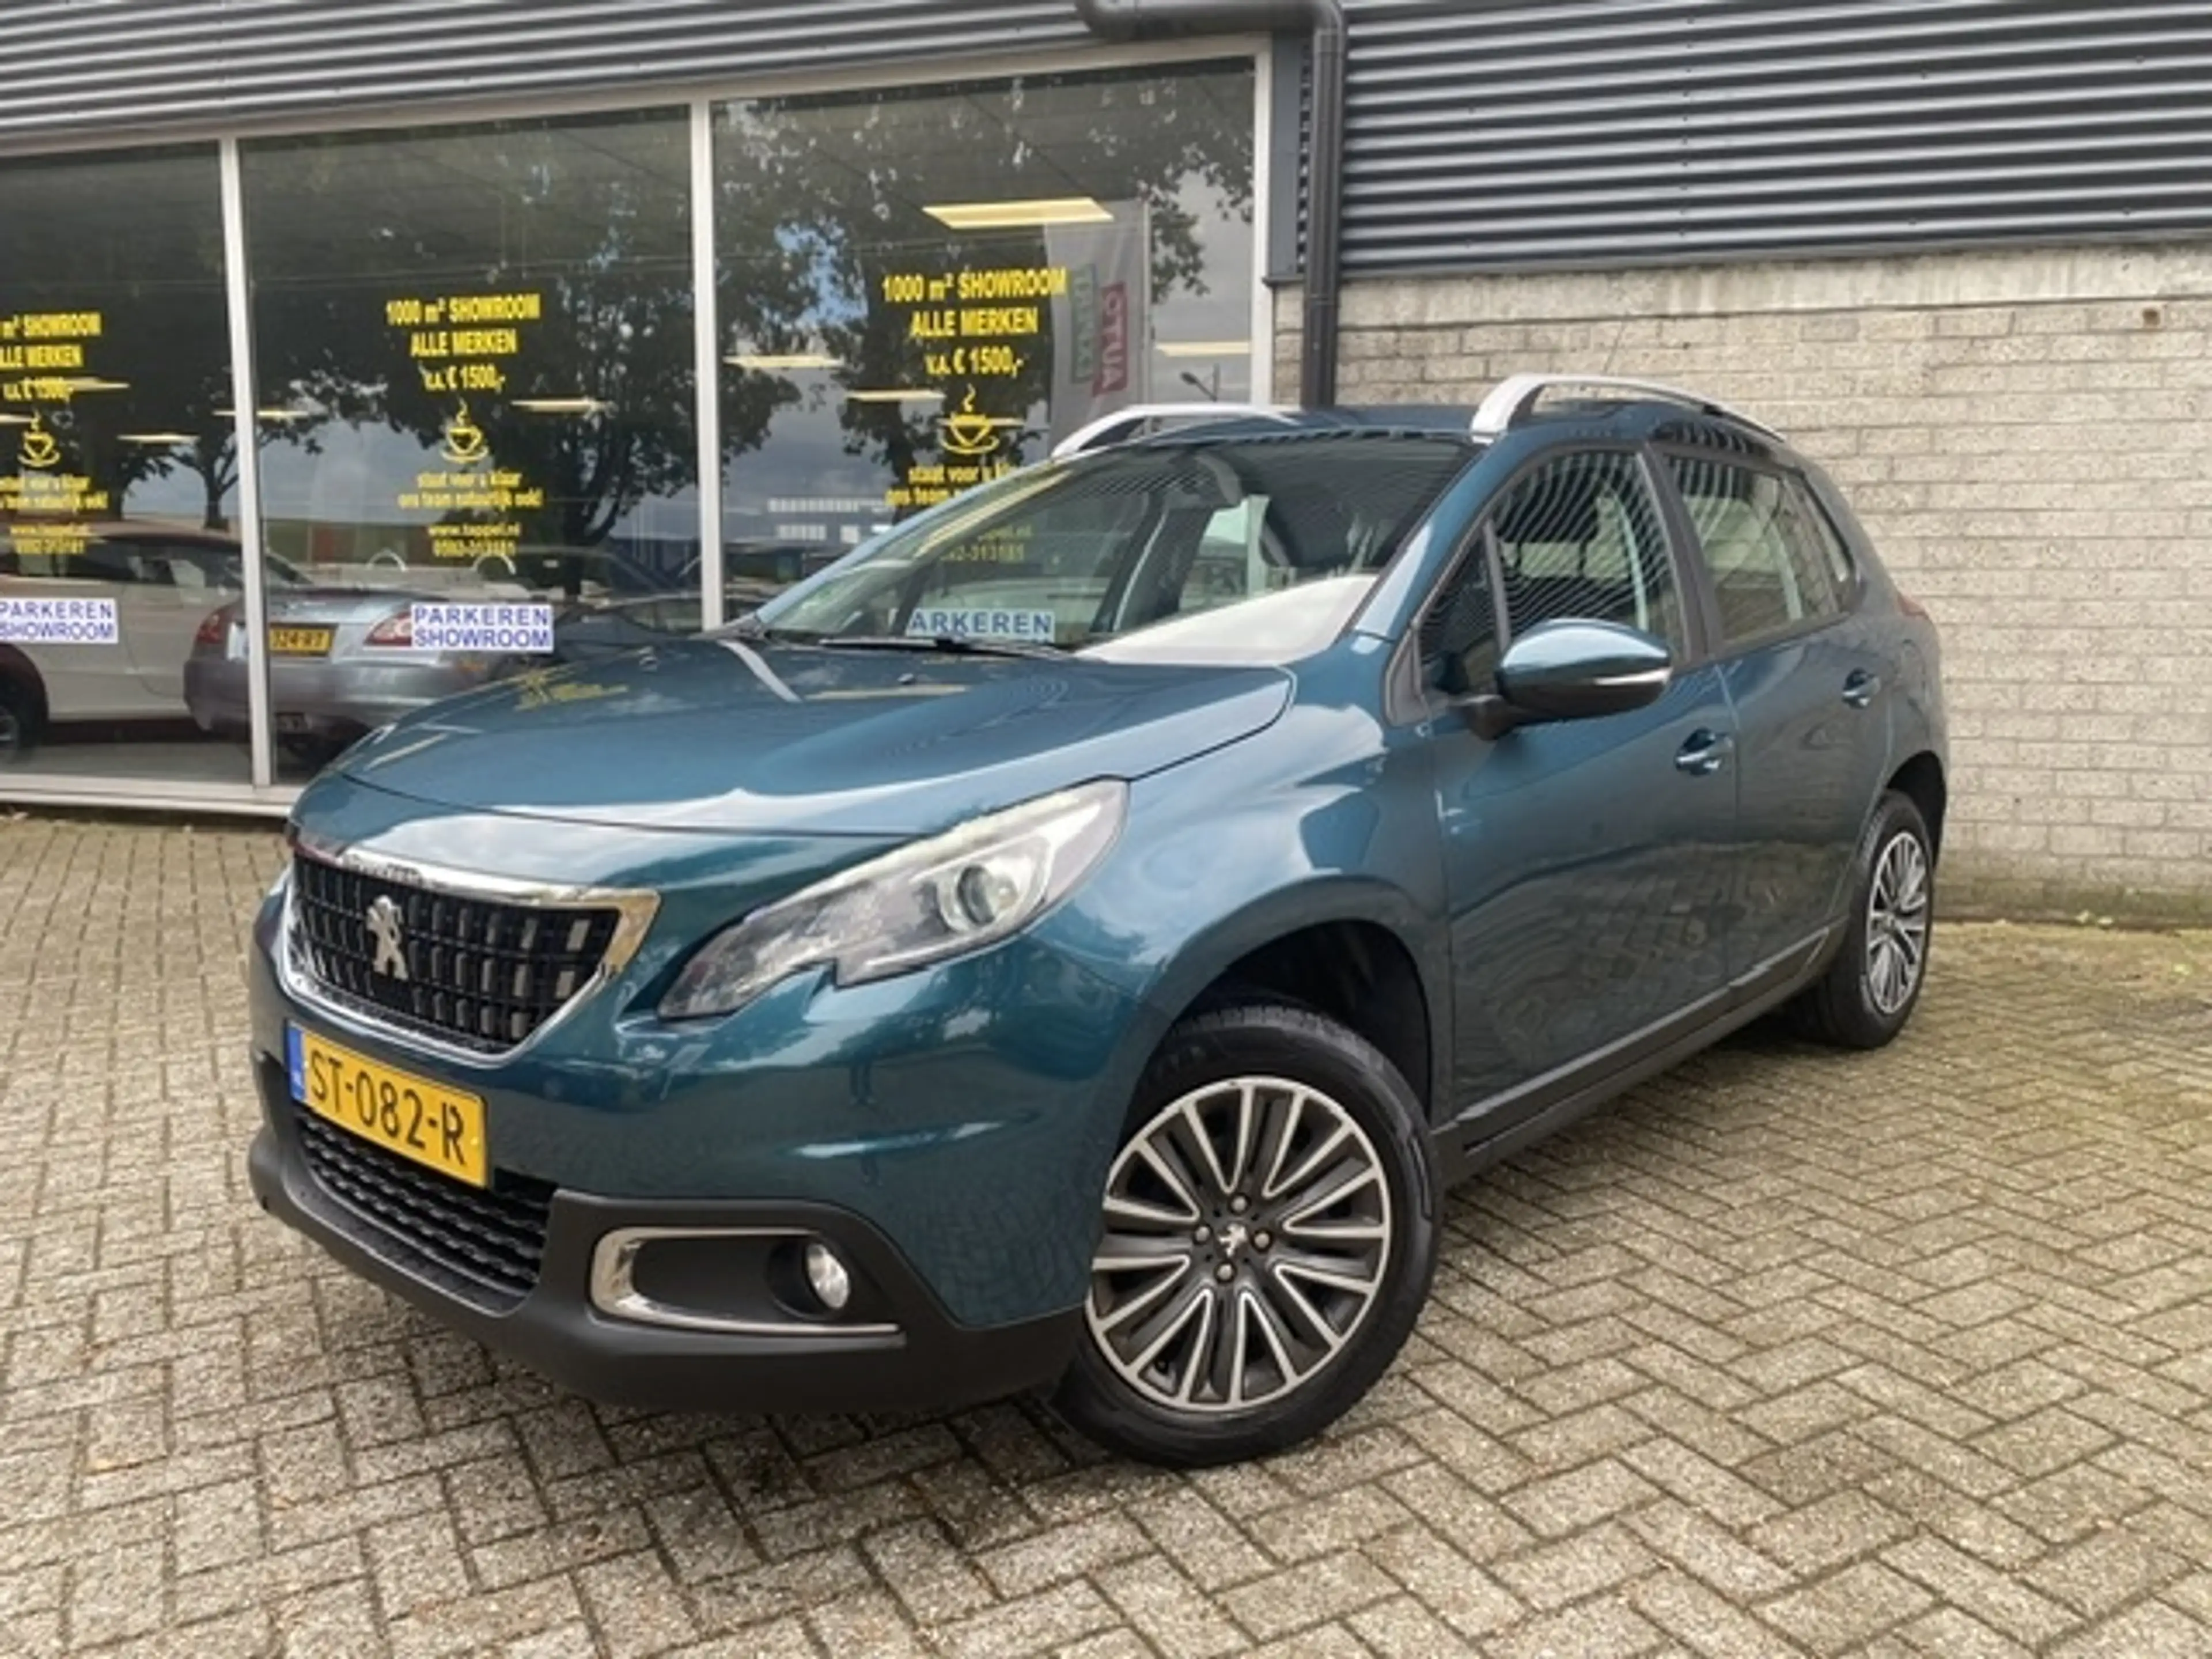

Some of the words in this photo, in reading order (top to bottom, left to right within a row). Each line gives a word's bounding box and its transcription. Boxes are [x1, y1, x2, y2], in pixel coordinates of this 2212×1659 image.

[882, 274, 923, 301] 1000
[957, 267, 1066, 299] SHOWROOM
[386, 300, 422, 326] 1000
[449, 293, 540, 323] SHOWROOM
[910, 310, 955, 337] ALLE
[961, 306, 1037, 335] MERKEN
[24, 312, 101, 336] SHOWROOM
[411, 331, 448, 357] ALLE
[452, 328, 516, 356] MERKEN
[0, 346, 23, 368] LLE
[27, 345, 84, 368] MERKEN
[953, 347, 965, 374] €
[414, 607, 547, 626] PARKEREN
[912, 611, 1051, 635] ARKEREN
[414, 628, 548, 647] SHOWROOM
[311, 1050, 465, 1165] ST-082-R
